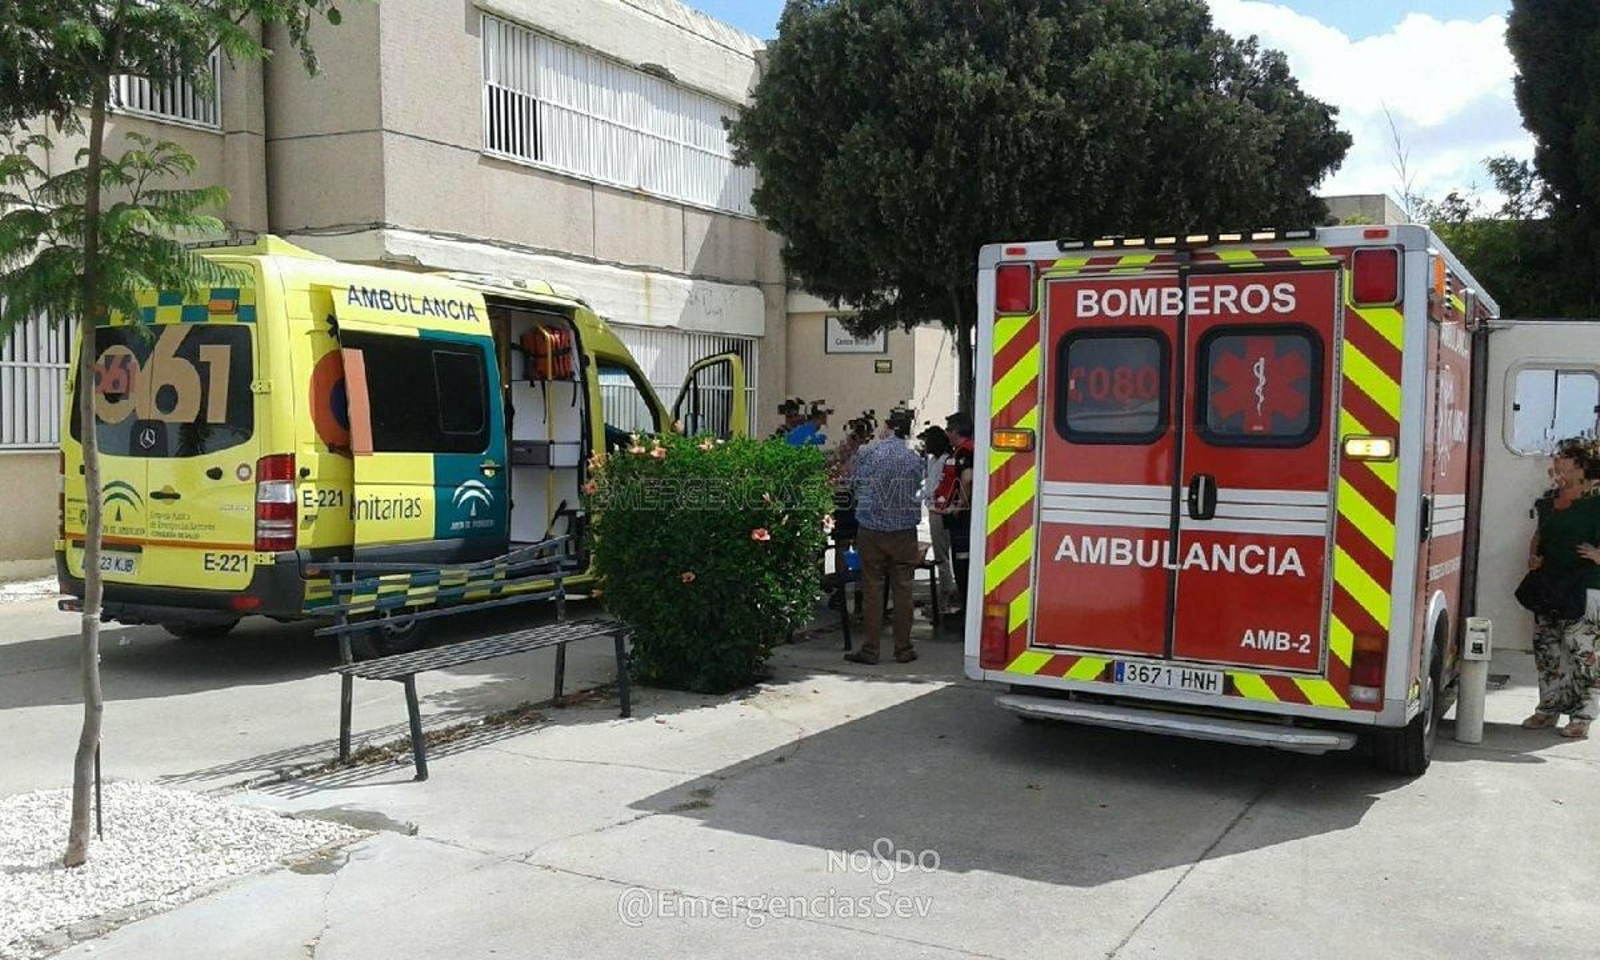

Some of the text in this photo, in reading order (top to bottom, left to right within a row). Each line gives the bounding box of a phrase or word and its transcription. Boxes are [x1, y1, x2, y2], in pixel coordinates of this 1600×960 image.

[347, 285, 479, 322] AMBULANCIA
[1077, 283, 1296, 317] BOMBEROS
[1088, 365, 1159, 403] 080
[303, 490, 343, 507] E-221
[114, 557, 134, 572] KJB
[204, 553, 248, 573] E-221
[1054, 535, 1305, 577] AMBULANCIA
[1240, 629, 1310, 653] AMB-2
[1127, 664, 1218, 692] 3671 HNH
